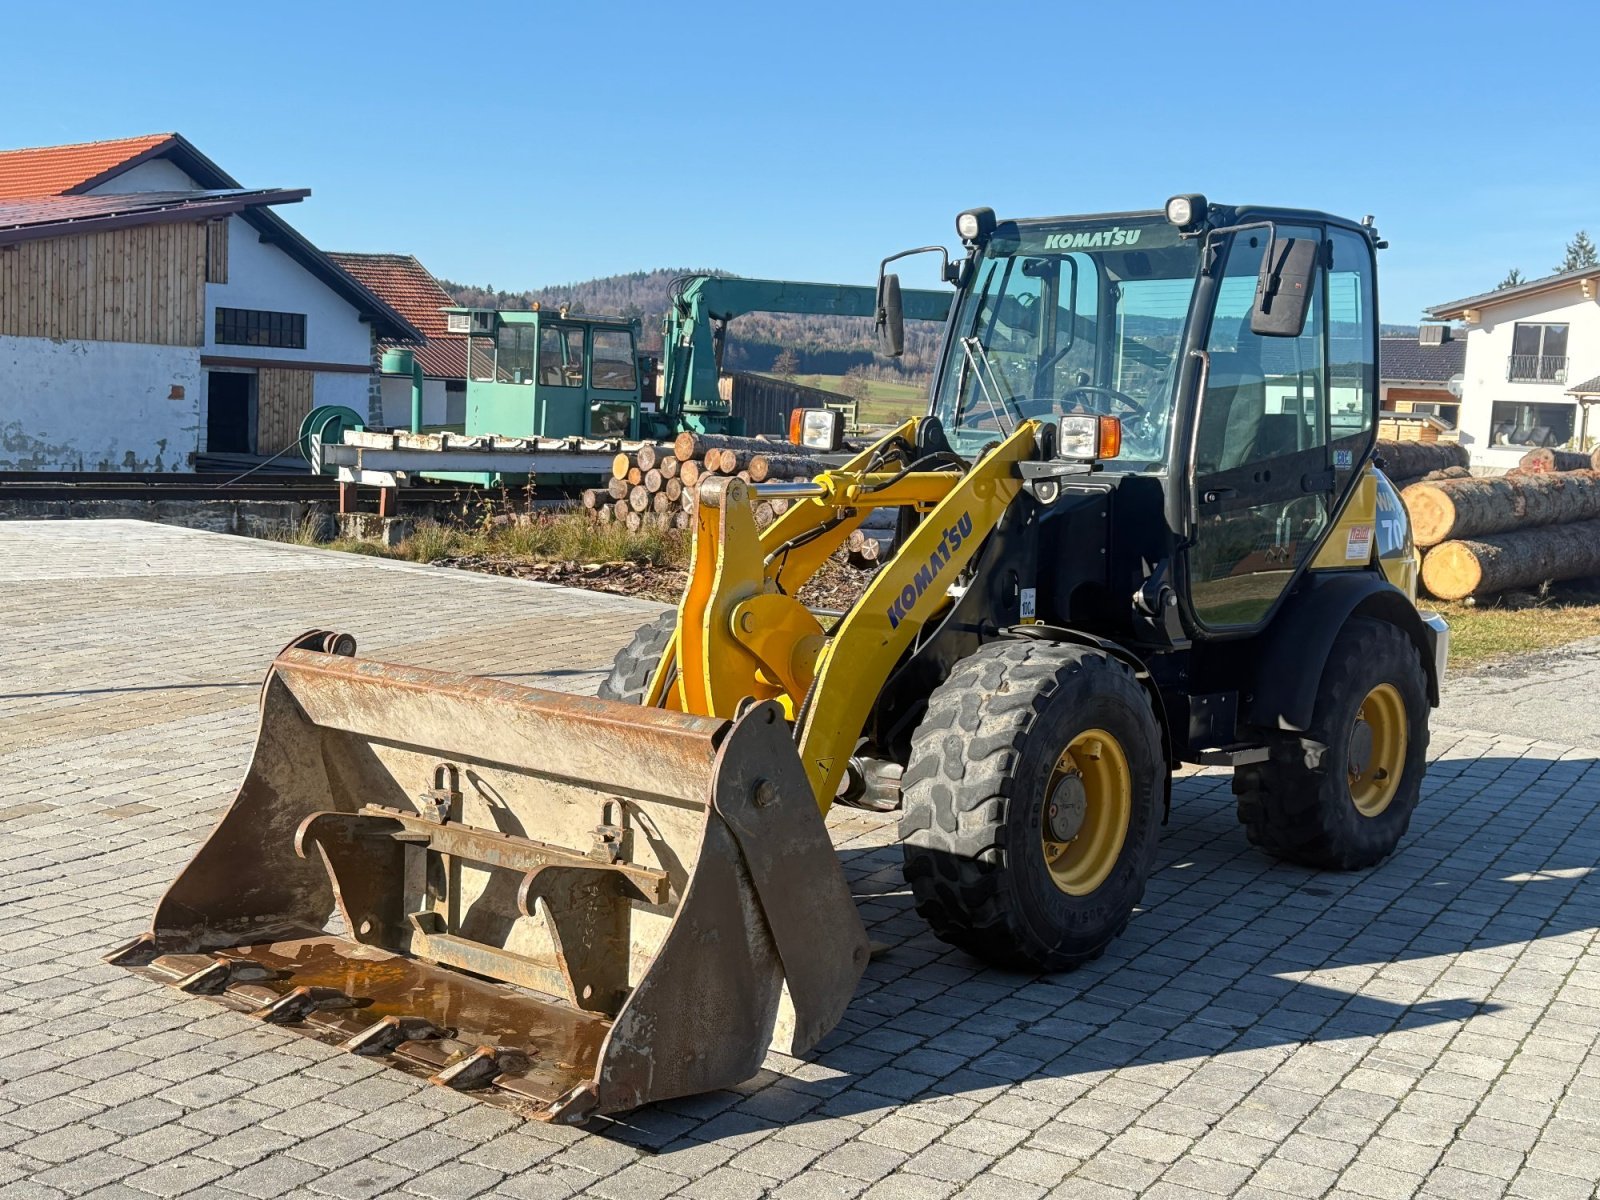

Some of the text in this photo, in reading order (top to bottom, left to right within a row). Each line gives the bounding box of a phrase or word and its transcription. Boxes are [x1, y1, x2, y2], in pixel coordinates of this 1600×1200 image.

[1044, 226, 1142, 250] KOMATSU
[1381, 519, 1404, 551] 70
[886, 510, 973, 631] KOMATSU
